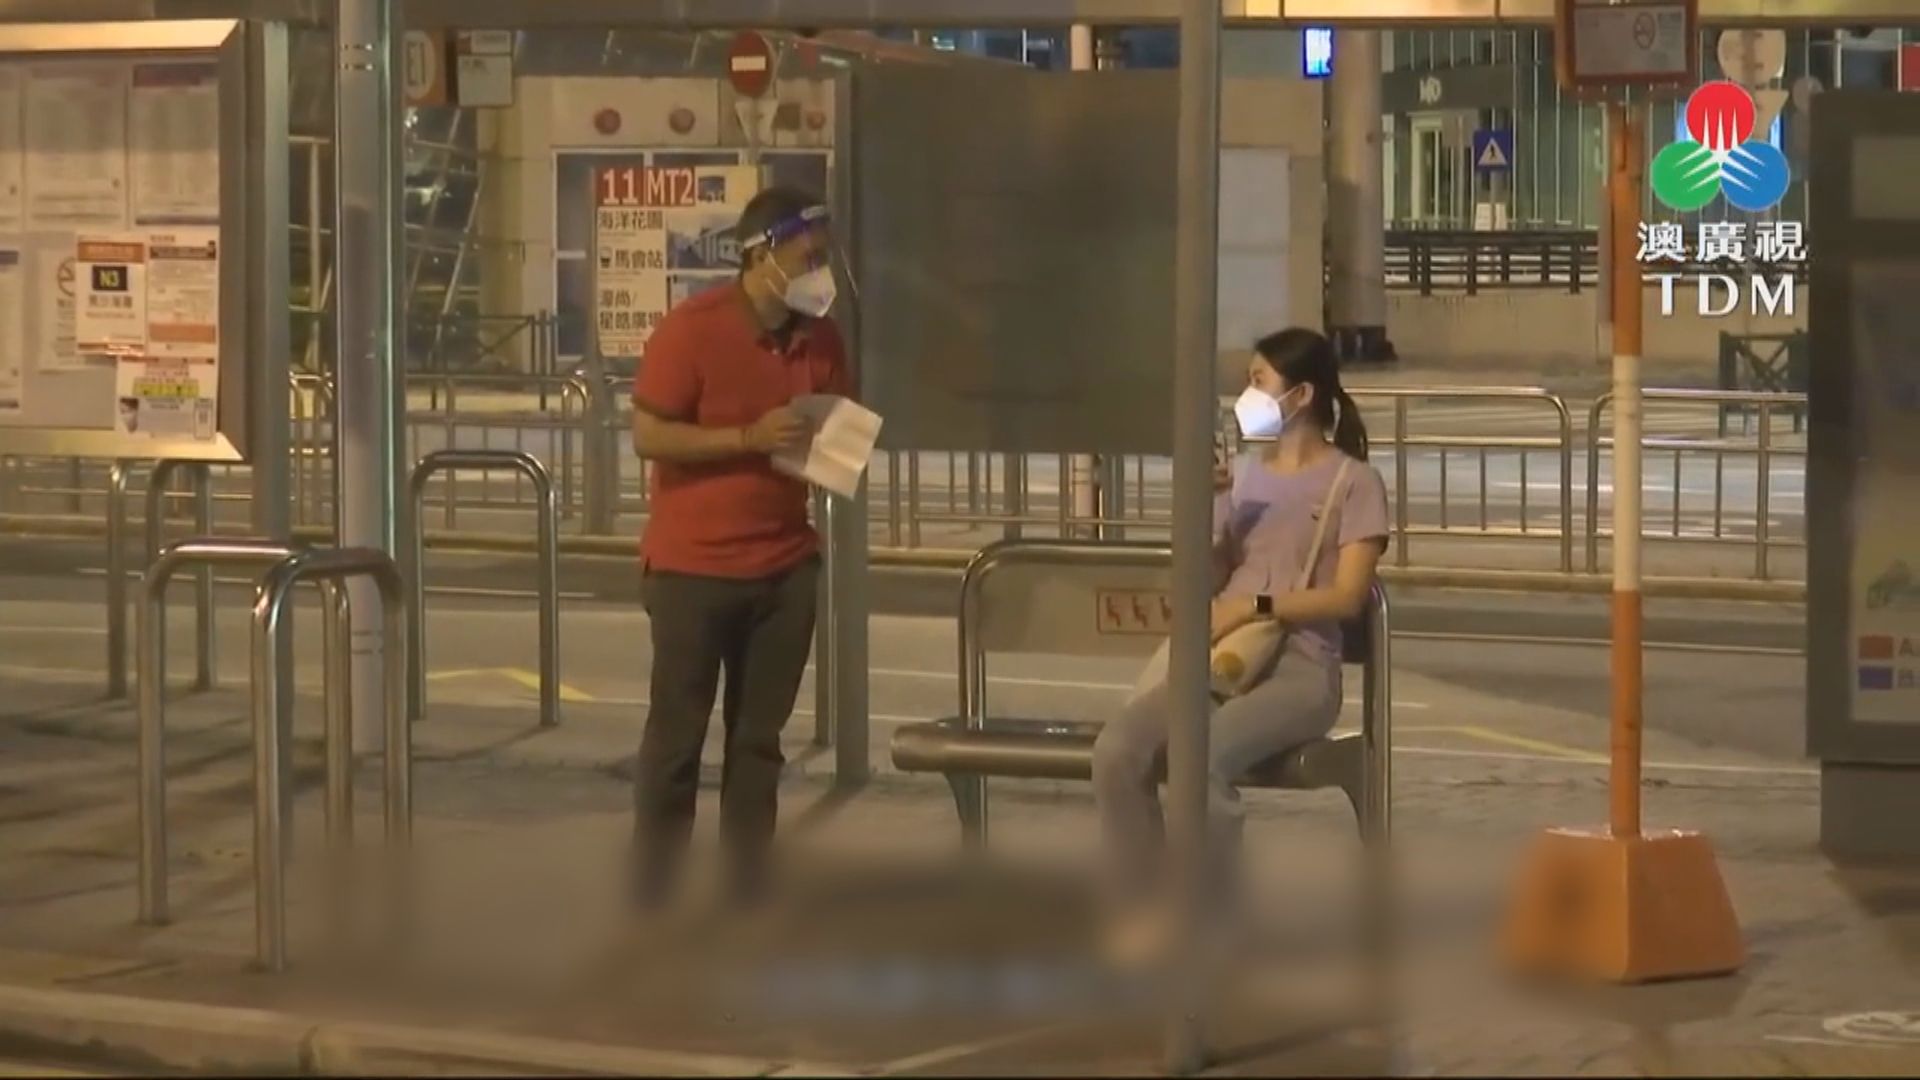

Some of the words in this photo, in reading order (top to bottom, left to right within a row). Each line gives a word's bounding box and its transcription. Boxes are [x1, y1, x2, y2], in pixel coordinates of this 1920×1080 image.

[602, 168, 638, 205] 11
[647, 168, 695, 205] MT2
[600, 210, 663, 231] 海洋花園
[615, 249, 663, 270] 馬會站
[100, 269, 120, 288] N3
